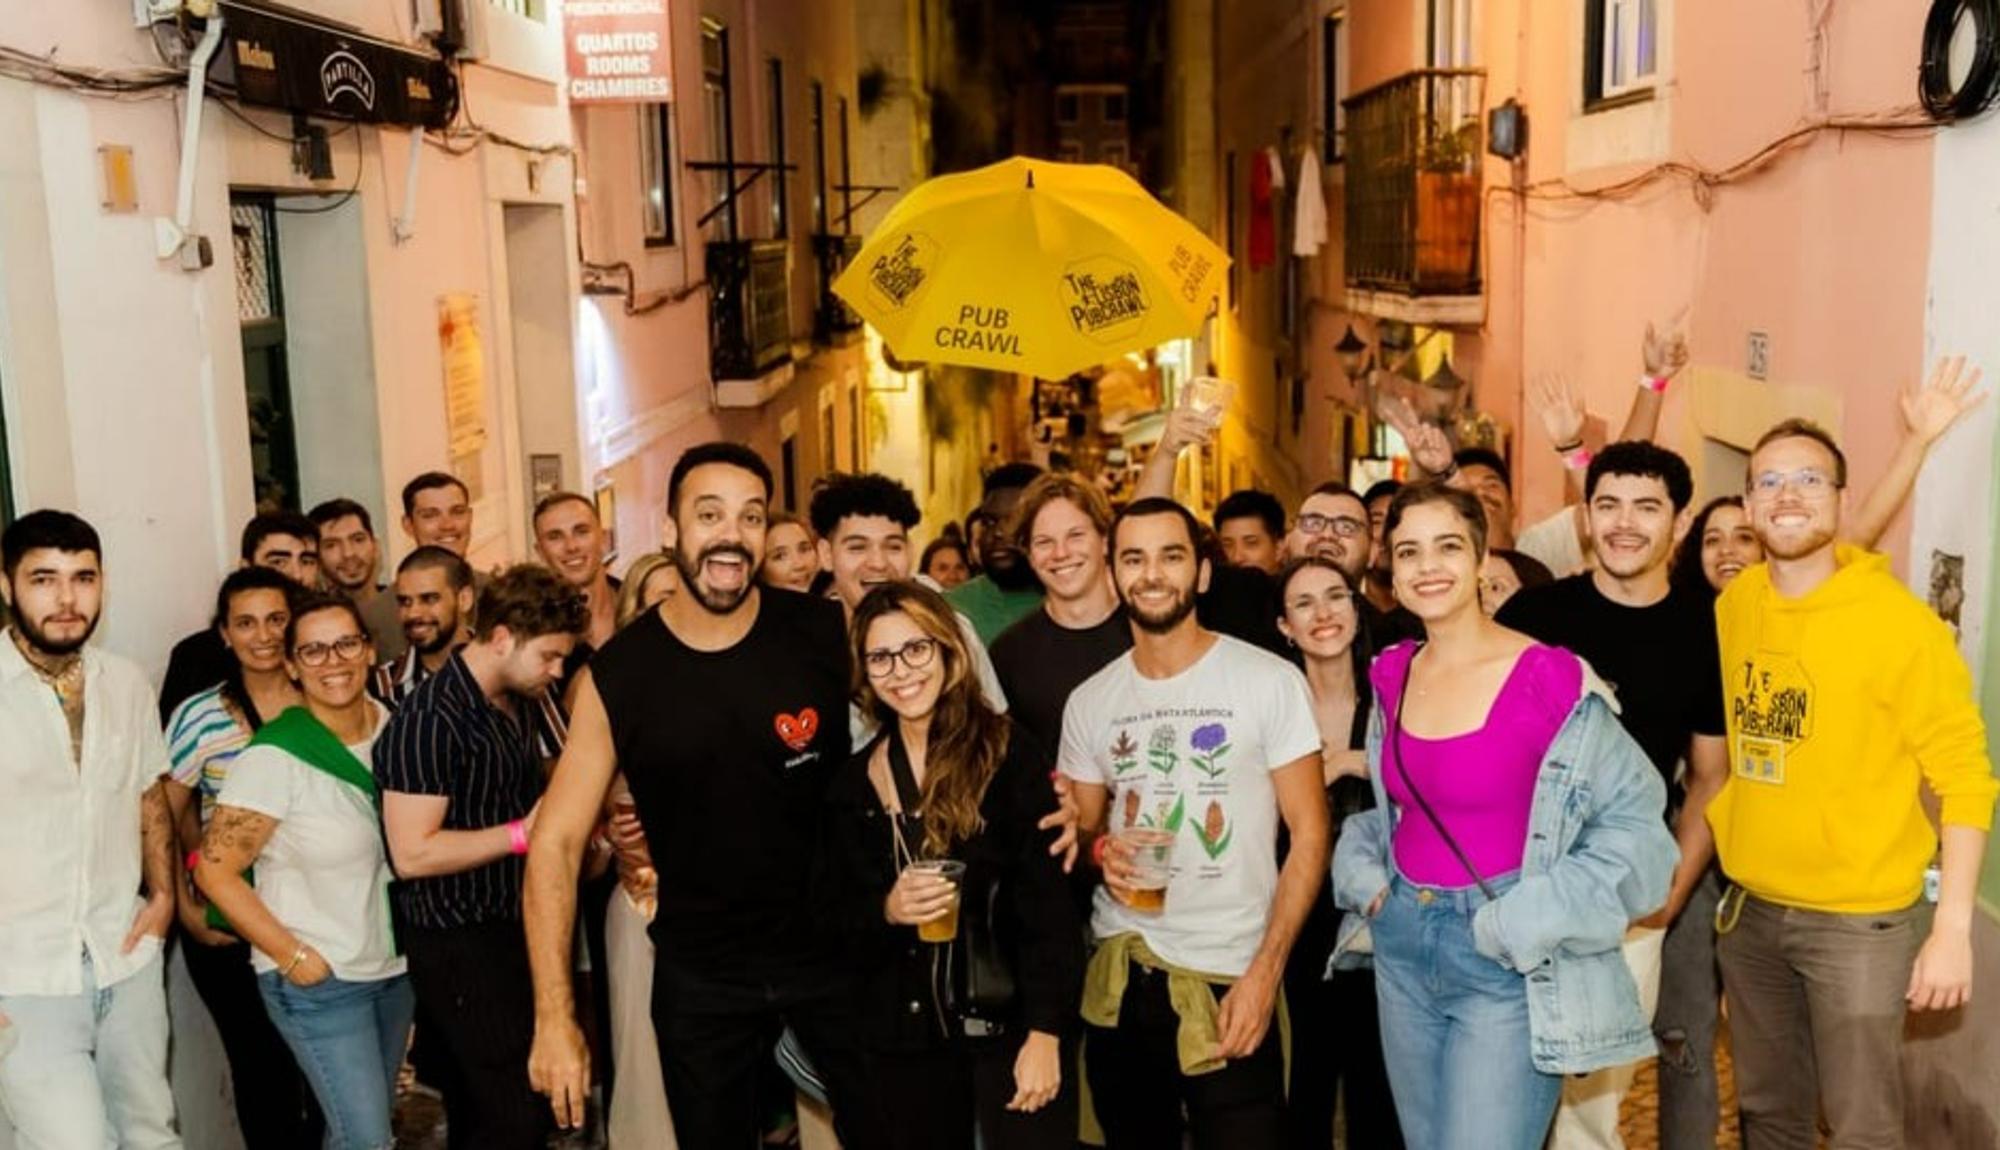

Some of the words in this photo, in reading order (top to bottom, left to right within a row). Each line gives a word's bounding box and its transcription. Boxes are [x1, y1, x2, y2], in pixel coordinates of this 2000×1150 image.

[576, 32, 659, 54] QUARTOS
[586, 55, 650, 76] ROOMS
[571, 77, 668, 99] CHAMBRES
[1169, 244, 1191, 278] PUB
[1180, 253, 1213, 304] CRAWL
[957, 303, 1009, 330] PUB
[934, 326, 1023, 357] CRAWL
